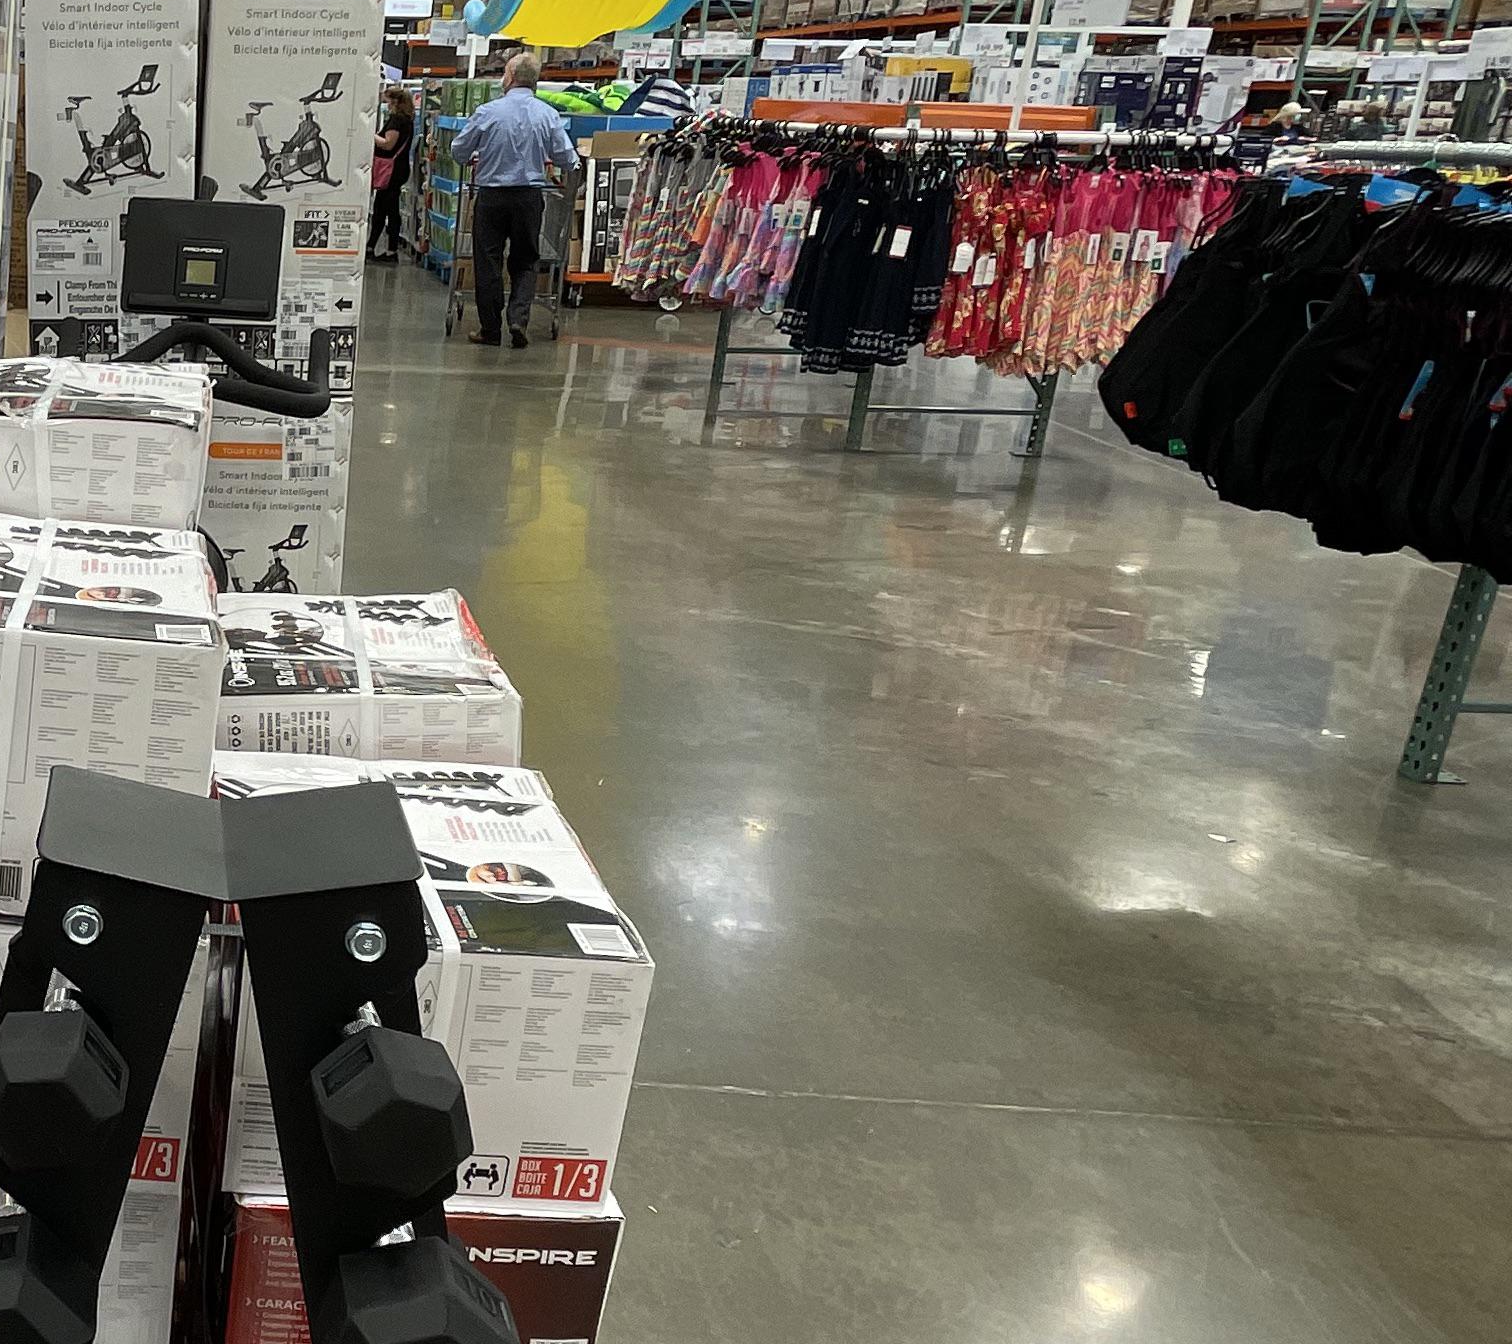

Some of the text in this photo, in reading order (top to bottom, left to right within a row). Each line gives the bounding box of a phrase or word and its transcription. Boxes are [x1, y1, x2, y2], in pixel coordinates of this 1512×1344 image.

[59, 2, 163, 15] Smart Indoor Cycle
[246, 9, 350, 22] Smart Indoor Cycle
[41, 20, 66, 31] Vélo
[126, 19, 180, 33] intelligent
[312, 27, 366, 40] intelligent
[49, 38, 172, 51] Bicicleta fija inteligente
[233, 44, 358, 58] Bicicleta fija inteligente
[219, 471, 248, 480] Smart
[516, 1160, 600, 1199] BOX BOITE CAJA 1/3
